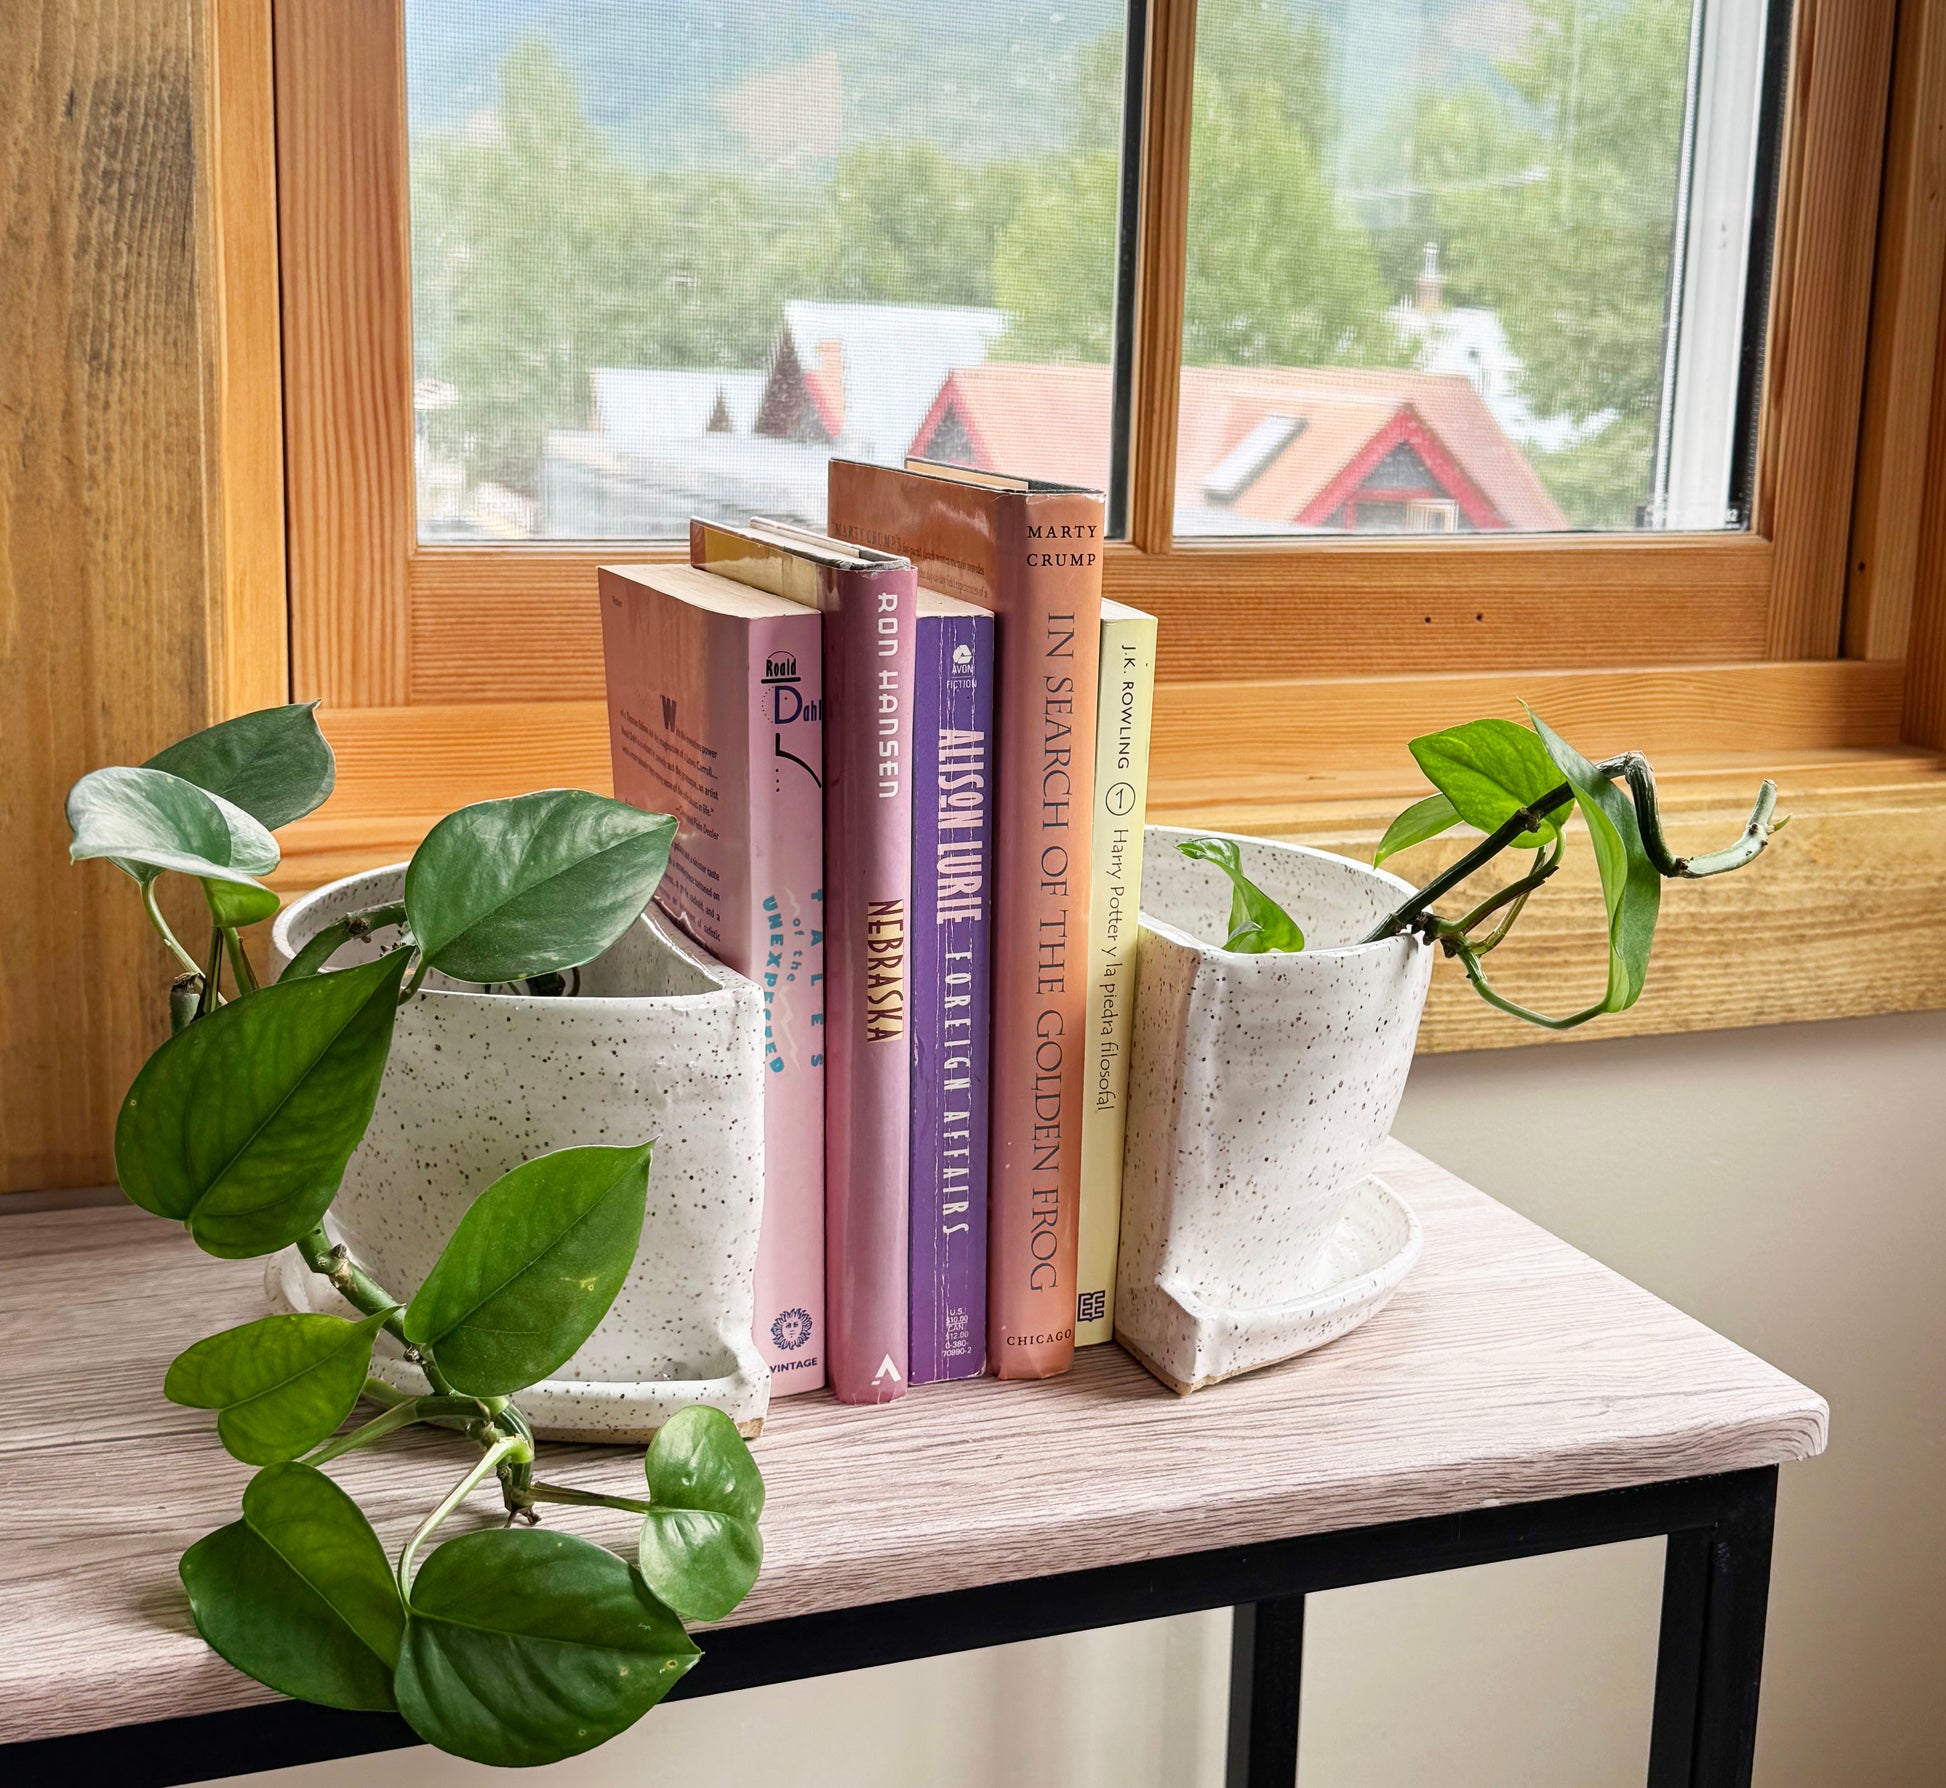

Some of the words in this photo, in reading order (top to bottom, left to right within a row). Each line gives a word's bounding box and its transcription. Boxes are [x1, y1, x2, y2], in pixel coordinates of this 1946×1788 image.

[1027, 525, 1097, 538] MARTY
[1026, 553, 1096, 567] CRUMP
[878, 592, 899, 657] RON
[1045, 611, 1075, 660] IN
[766, 658, 797, 678] Roald
[946, 679, 977, 690] FICTION
[952, 663, 974, 674] AVON
[1121, 645, 1137, 674] J.K.
[774, 685, 823, 725] Dahl
[1117, 681, 1134, 769] ROWLING
[878, 670, 899, 798] HANSEN
[1042, 675, 1075, 830] SEARCH
[938, 728, 985, 829] ALISON
[1040, 845, 1069, 897] OF
[1106, 829, 1129, 879] Harry
[936, 840, 983, 925] LURIE
[792, 918, 804, 936] of
[1106, 886, 1125, 939] Potter
[786, 950, 802, 982] the
[867, 899, 904, 1041] NEBRASKA
[1035, 909, 1068, 995] THE
[1101, 949, 1117, 957] y
[1103, 962, 1123, 977] la
[810, 889, 824, 1068] TALES
[943, 951, 973, 1091] FOREIGN
[1099, 983, 1119, 1035] piedra
[1031, 1009, 1065, 1172] GOLDEN
[1096, 1042, 1119, 1110] filosofal
[942, 1111, 971, 1234] AFFAIRS
[1030, 1186, 1060, 1292] FROG
[941, 1346, 972, 1358] 70990-2
[1006, 1329, 1073, 1346] CHICAGO
[769, 1357, 818, 1374] VINTAGE
